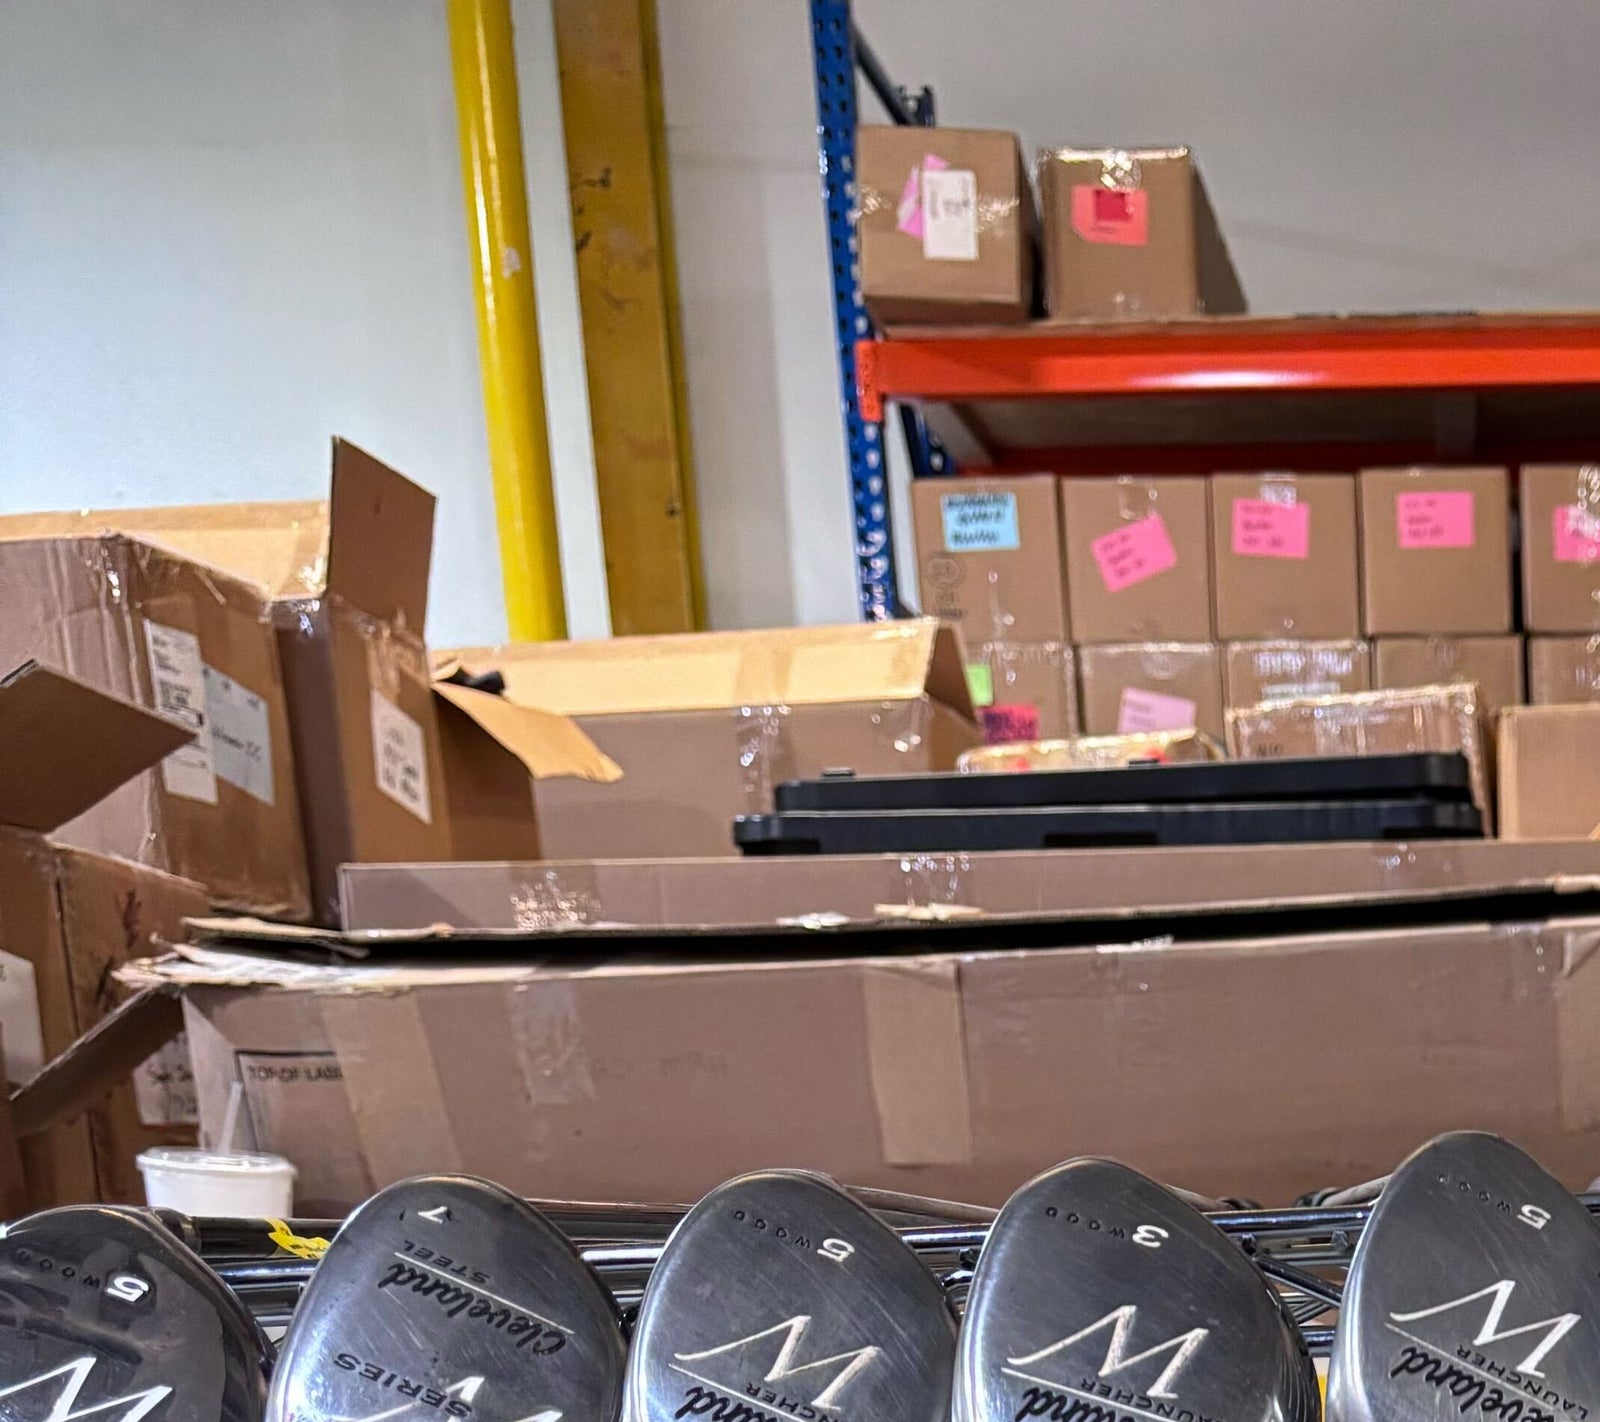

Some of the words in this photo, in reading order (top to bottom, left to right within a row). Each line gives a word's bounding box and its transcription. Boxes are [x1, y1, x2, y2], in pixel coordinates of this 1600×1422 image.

[1132, 1224, 1168, 1248] 3
[1516, 1203, 1551, 1230] 5
[402, 1238, 491, 1286] STEEL
[817, 1237, 855, 1263] 5
[107, 1275, 149, 1302] 5
[378, 1262, 567, 1357] Cleveland
[1006, 1304, 1209, 1399] W
[1389, 1279, 1582, 1379] W
[333, 1352, 473, 1418] SERIES
[673, 1314, 881, 1411] W
[1456, 1344, 1590, 1420] LAUNCHER
